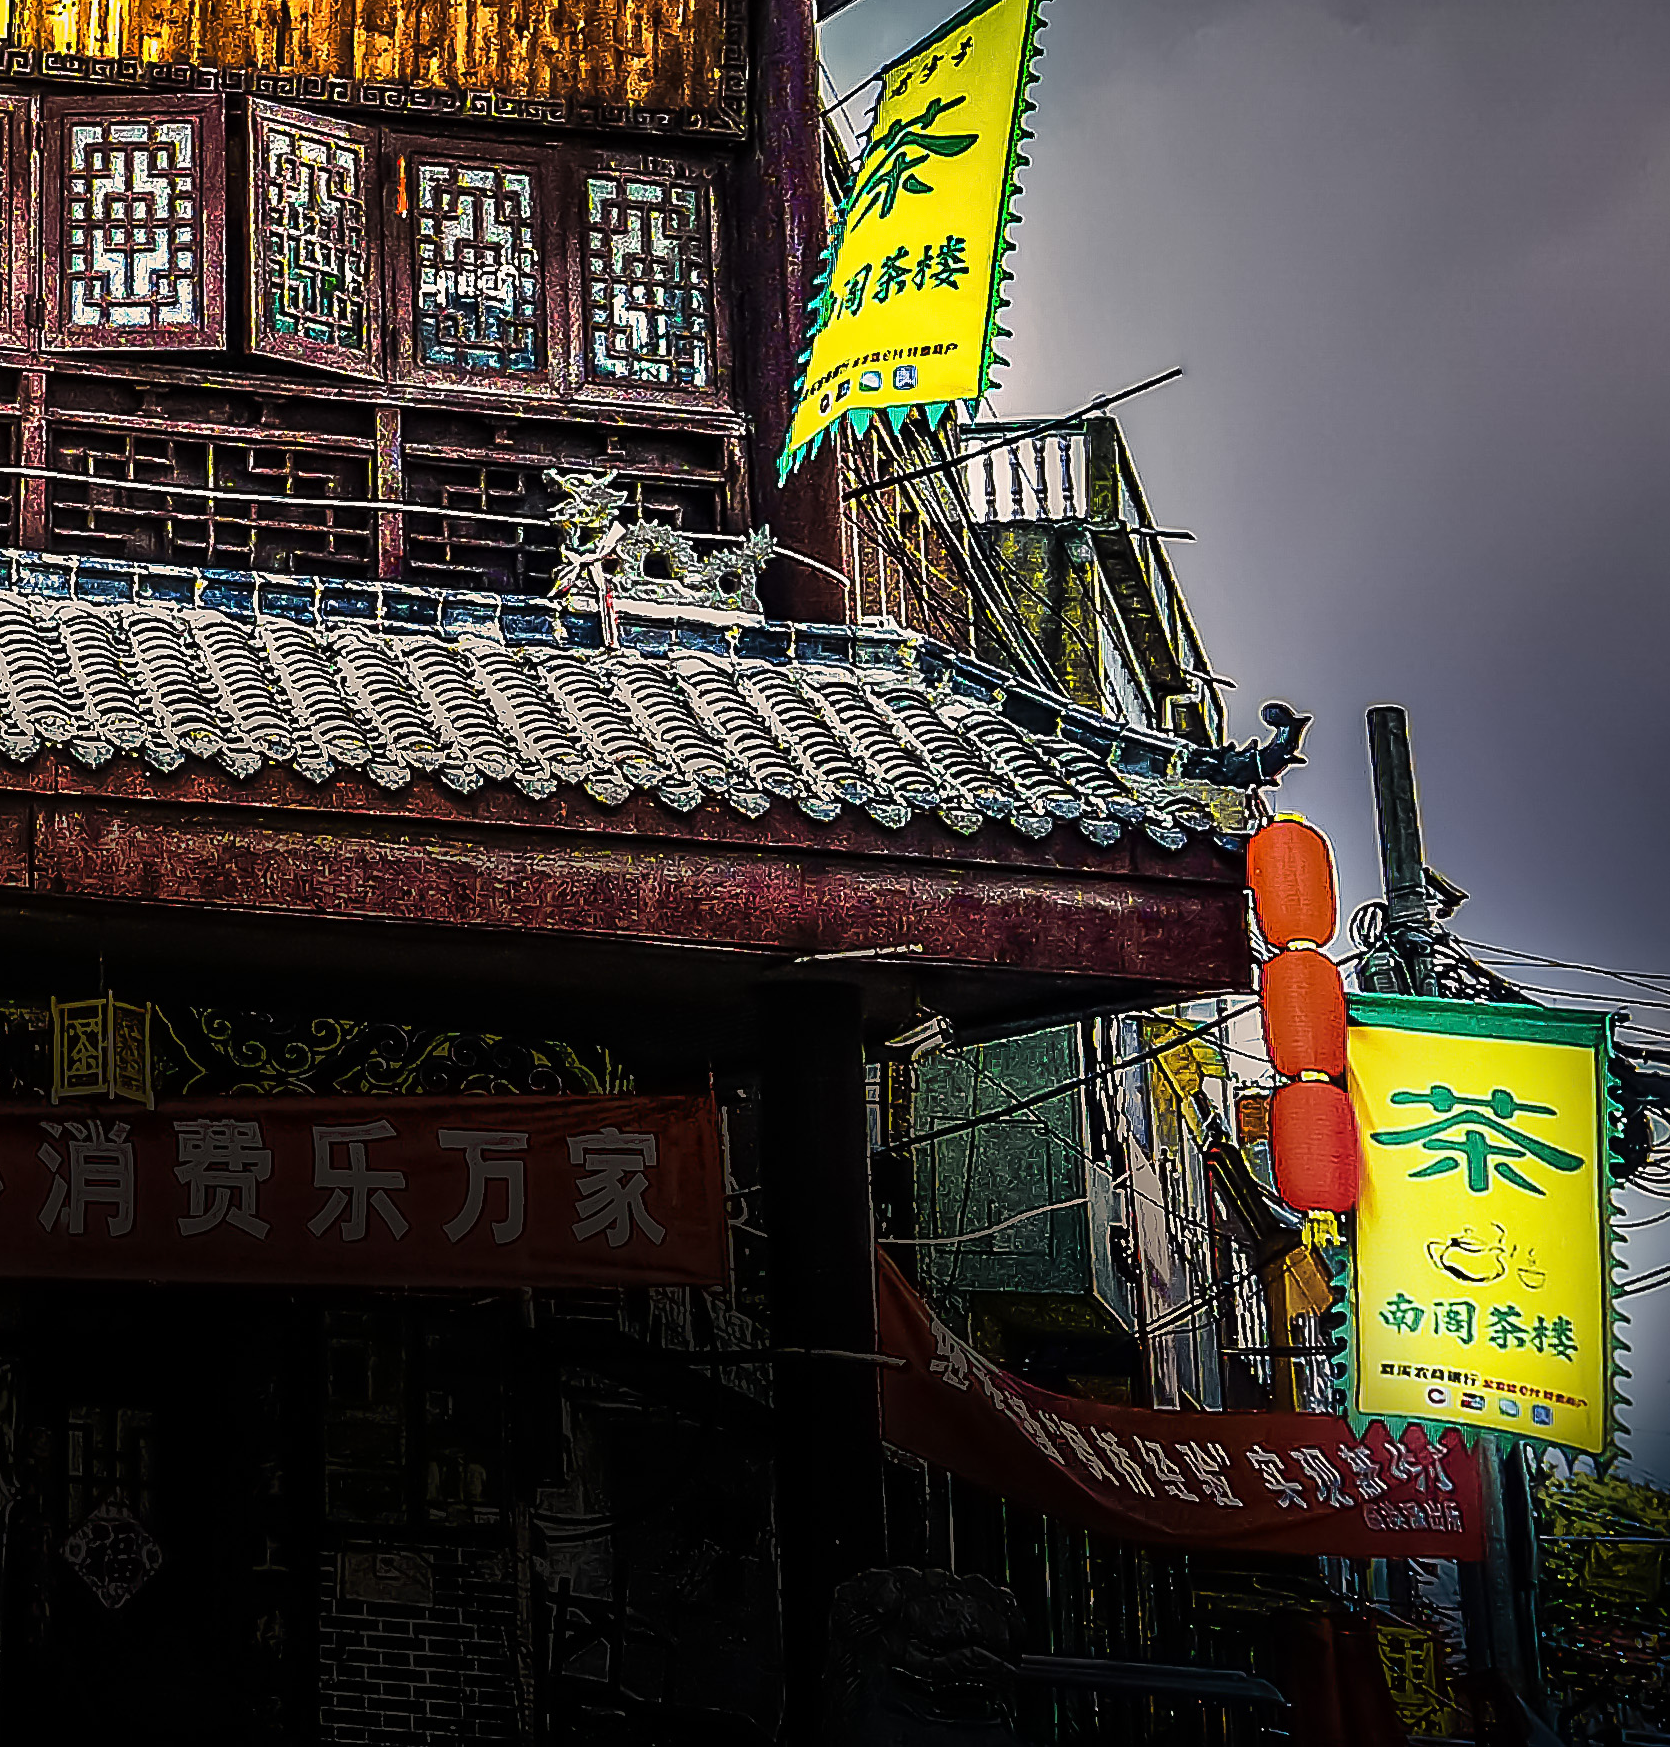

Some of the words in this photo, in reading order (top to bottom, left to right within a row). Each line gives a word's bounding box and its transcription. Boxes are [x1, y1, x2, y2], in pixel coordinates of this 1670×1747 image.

[849, 95, 979, 233] 茶
[1370, 1085, 1585, 1196] 茶
[1379, 1292, 1579, 1362] 南阁茶楼
